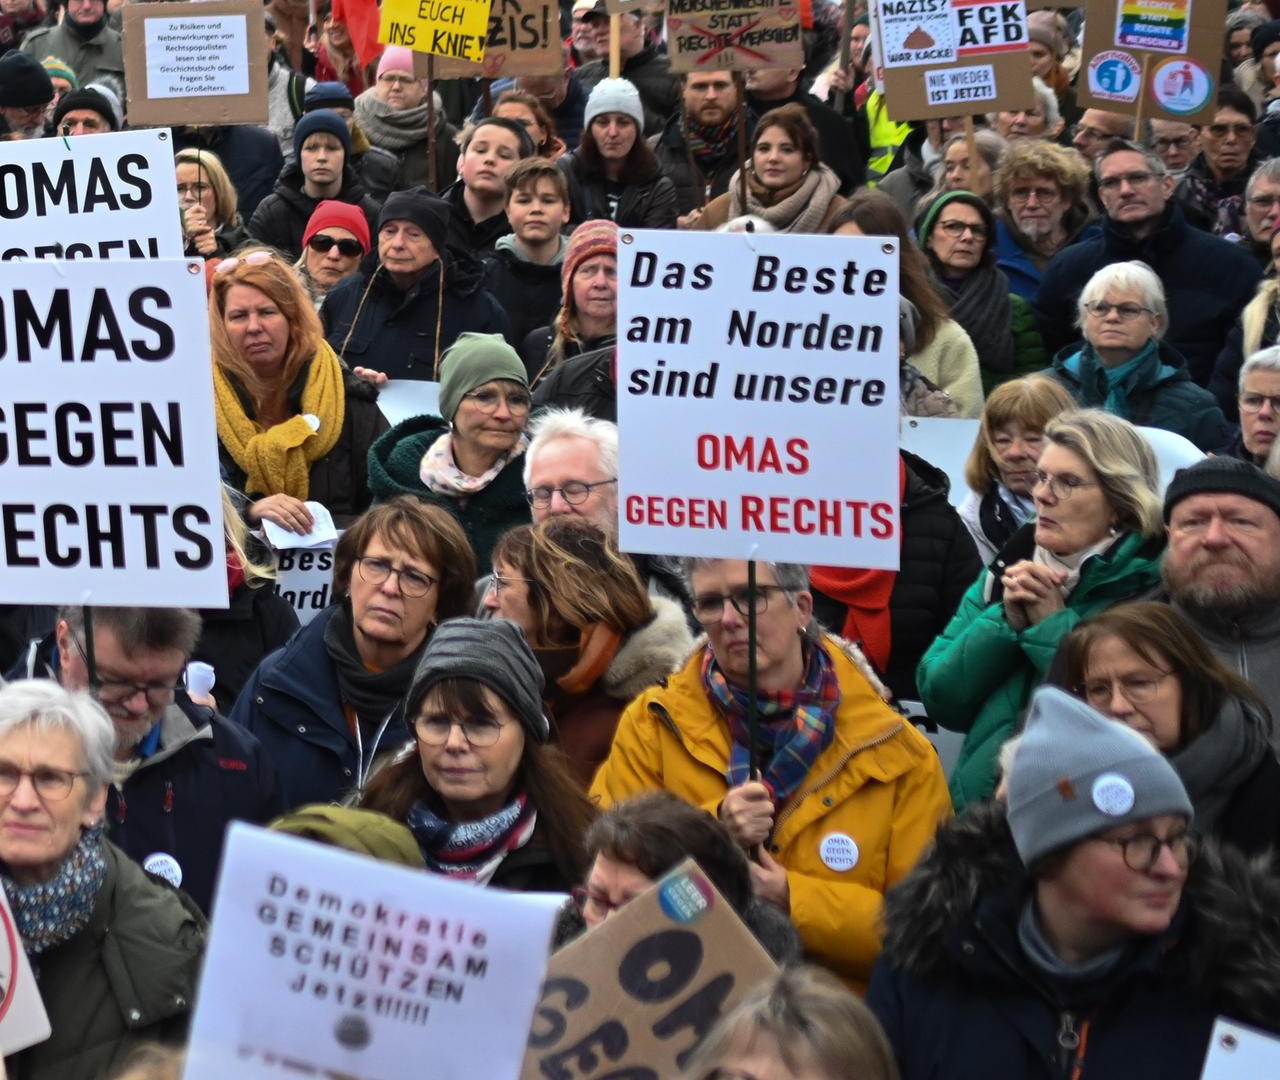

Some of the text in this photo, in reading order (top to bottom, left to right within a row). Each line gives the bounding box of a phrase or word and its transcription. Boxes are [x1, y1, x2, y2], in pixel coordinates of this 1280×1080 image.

[418, 0, 464, 25] EUCH
[708, 11, 756, 29] STATT
[958, 4, 1022, 26] FCK
[158, 33, 219, 42] Nebenwirkungen
[389, 23, 486, 61] INS KNIE!
[959, 24, 1023, 46] AFD
[1126, 35, 1179, 48] MENSCHEN
[888, 52, 911, 63] WAR
[160, 65, 216, 73] Geschichtsbuch
[180, 75, 203, 83] fragen
[930, 71, 990, 86] NIE WIEDER
[931, 86, 992, 101] IST JETZT!
[630, 251, 888, 297] Das Beste
[626, 310, 883, 352] am Norden
[628, 360, 886, 407] sind unsere
[697, 434, 810, 475] OMAS
[626, 495, 894, 540] GEGEN RECHTS
[278, 550, 332, 571] Bes
[825, 857, 853, 865] RECHTS
[268, 873, 488, 949] Demokratie
[258, 902, 488, 978] GEMEINSAM
[269, 934, 465, 1004] SCHÜTZEN
